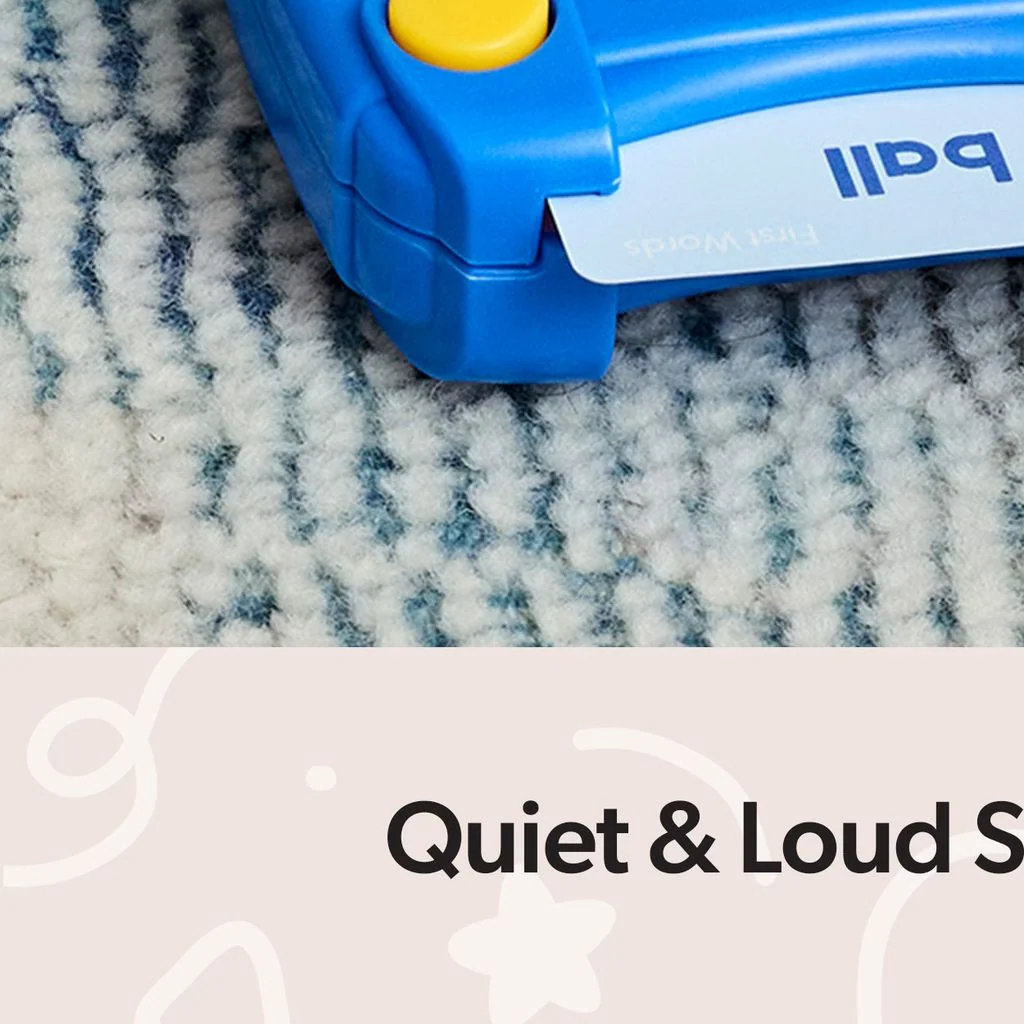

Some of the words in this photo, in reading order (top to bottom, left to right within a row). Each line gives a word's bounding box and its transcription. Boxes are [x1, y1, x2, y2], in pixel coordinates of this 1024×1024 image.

[824, 132, 1013, 199] ball
[626, 228, 741, 260] Words
[744, 223, 819, 247] First
